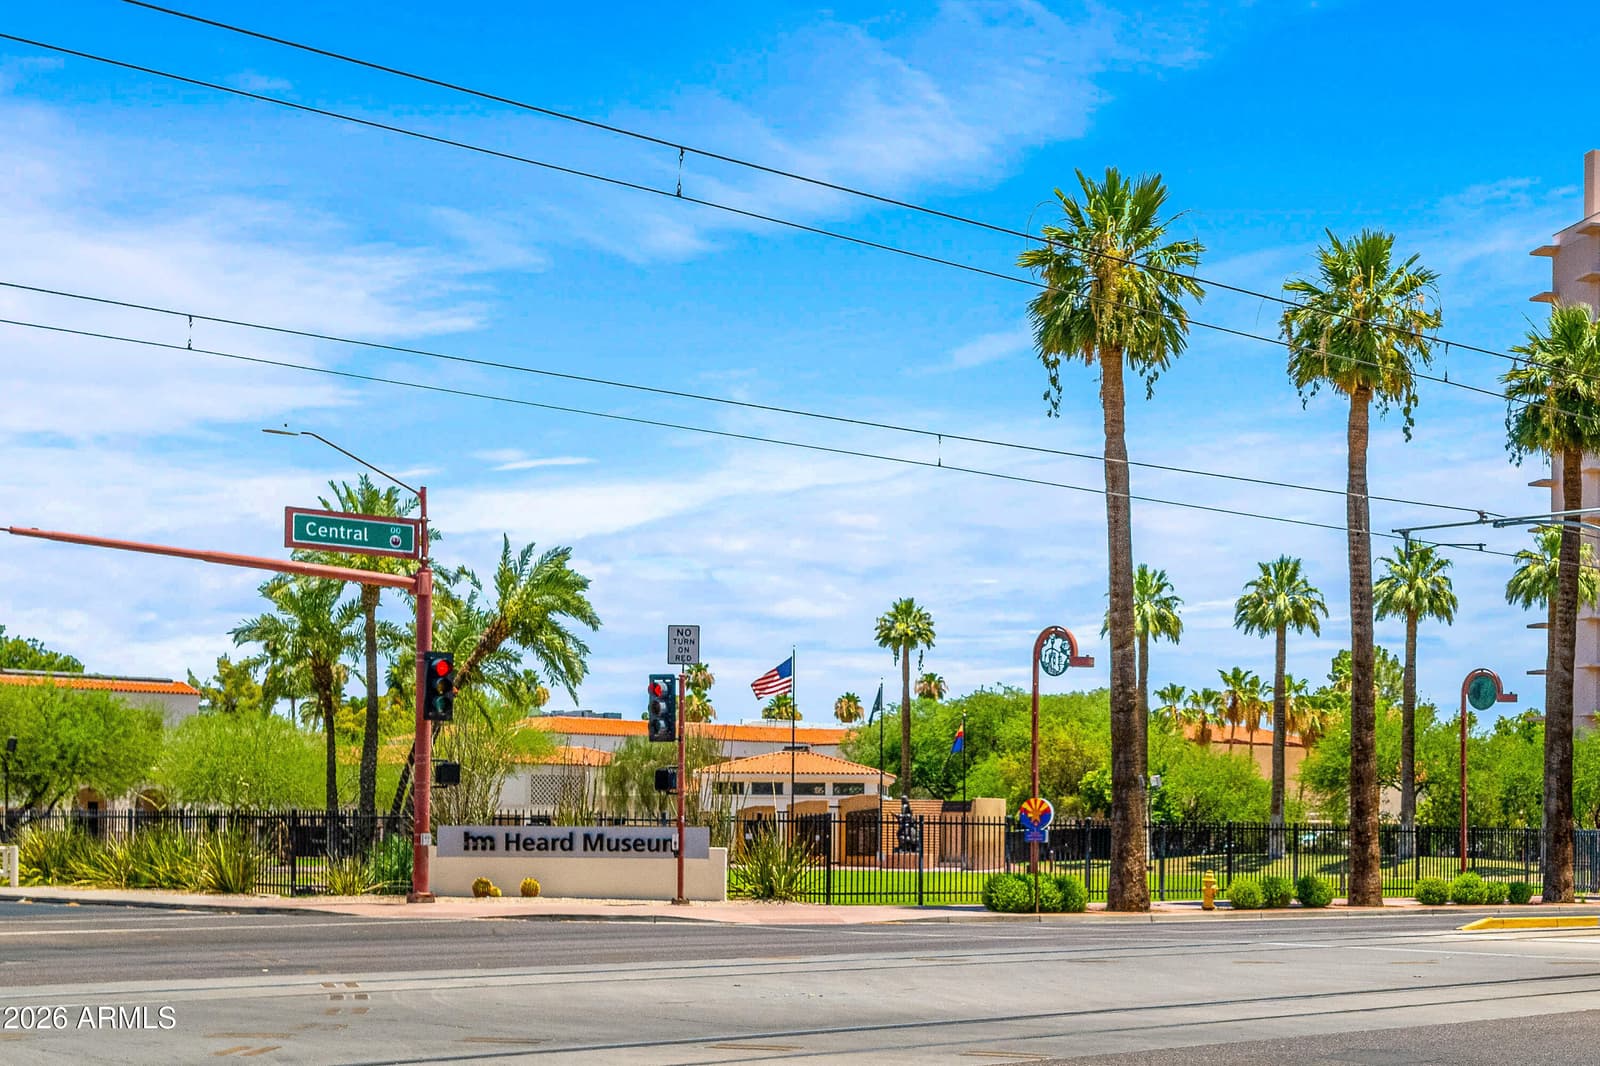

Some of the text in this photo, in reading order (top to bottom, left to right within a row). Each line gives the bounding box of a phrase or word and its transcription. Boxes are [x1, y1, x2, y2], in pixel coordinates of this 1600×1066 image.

[305, 521, 369, 542] Central
[676, 628, 692, 637] NO
[675, 654, 692, 662] RED
[504, 831, 574, 852] Heard
